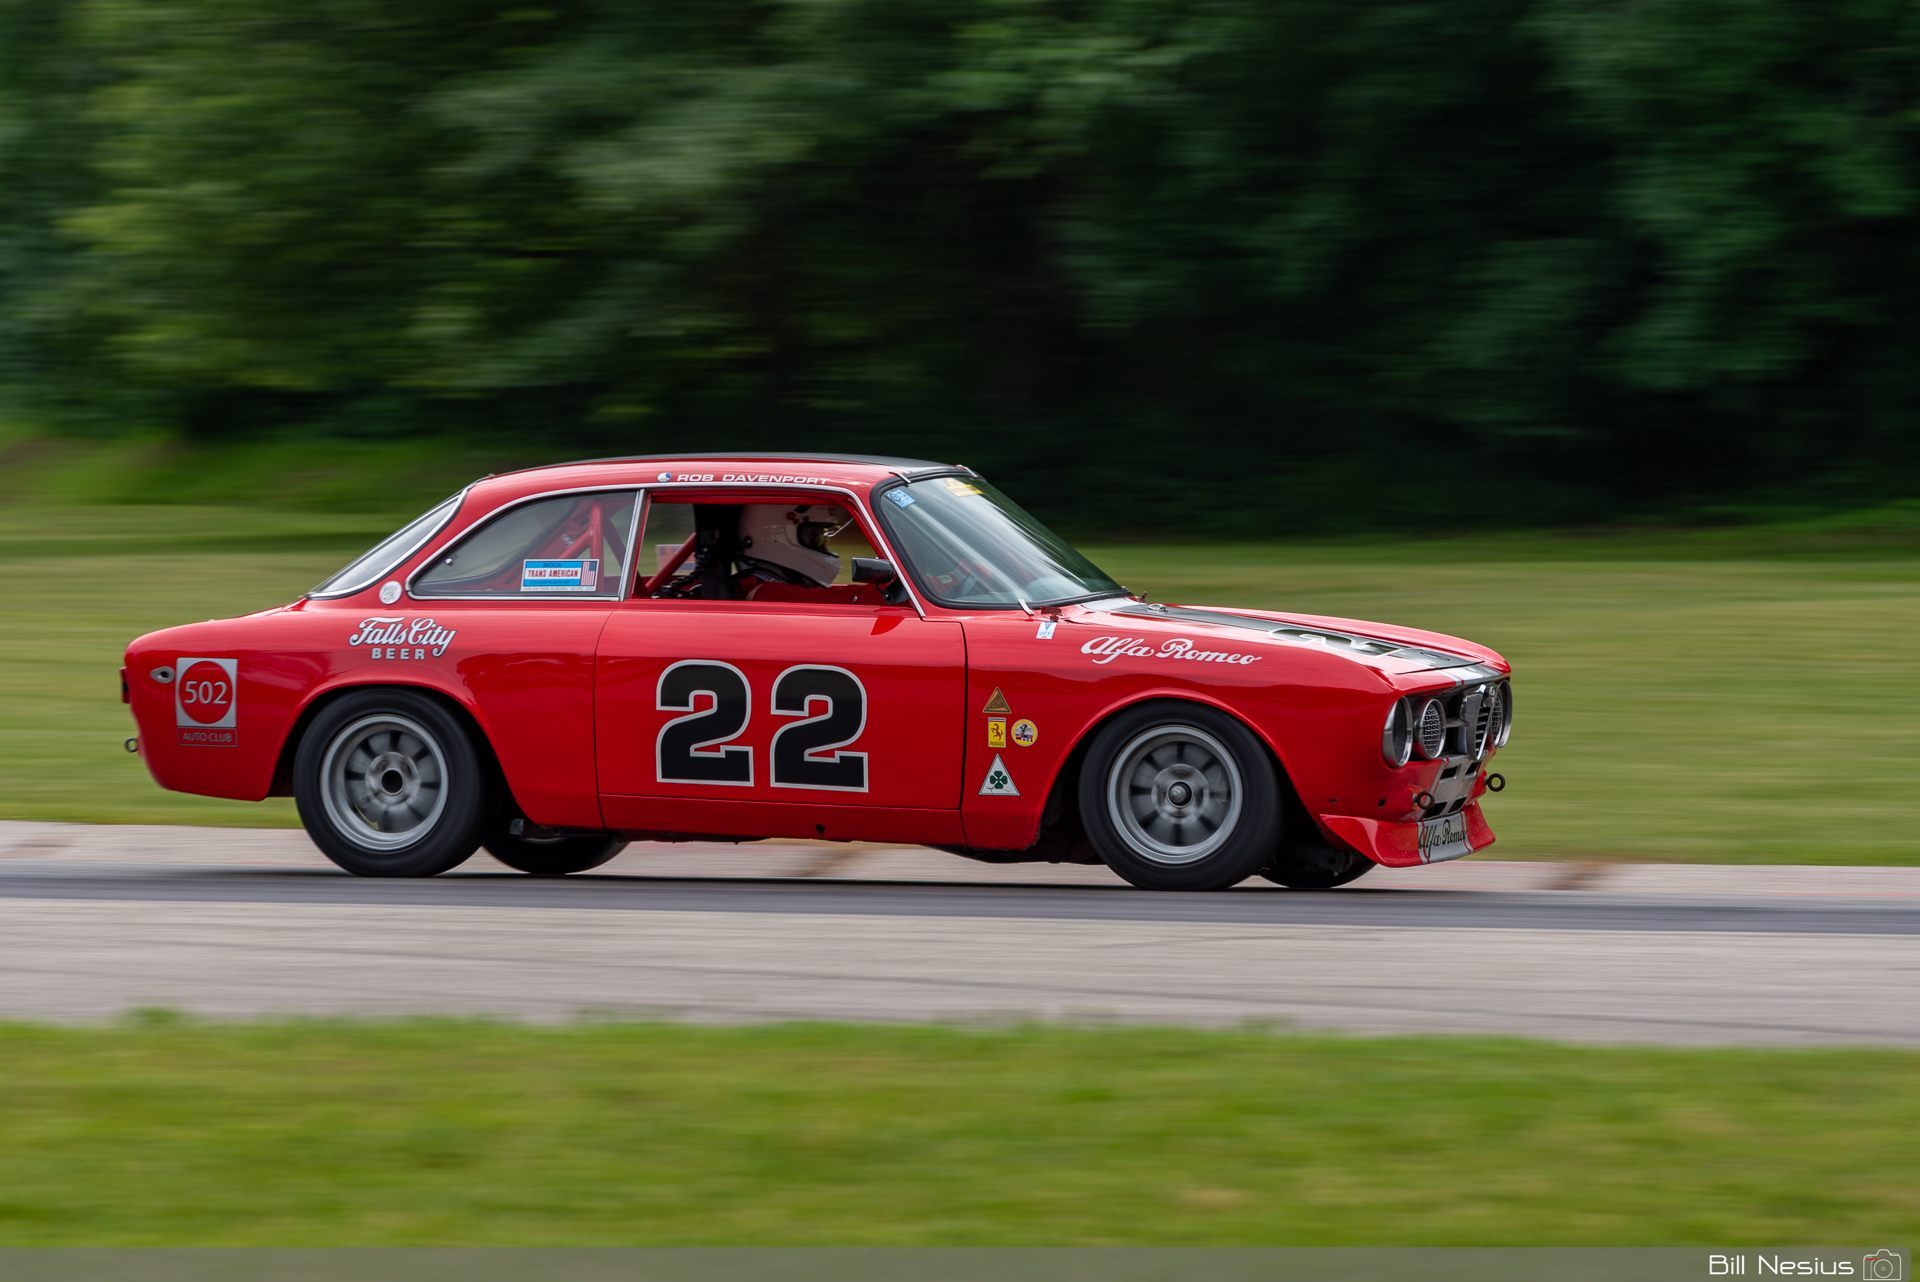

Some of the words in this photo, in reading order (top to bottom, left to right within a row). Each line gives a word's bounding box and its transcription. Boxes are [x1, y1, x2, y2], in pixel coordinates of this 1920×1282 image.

[677, 474, 714, 482] ROB
[722, 474, 830, 485] DAVENPORT
[371, 648, 425, 660] BEER
[1081, 636, 1154, 664] Alfa
[1156, 638, 1262, 665] Romeo
[184, 681, 227, 704] 502
[656, 659, 869, 793] 22
[183, 732, 207, 742] AUTO
[208, 733, 232, 743] CLUB
